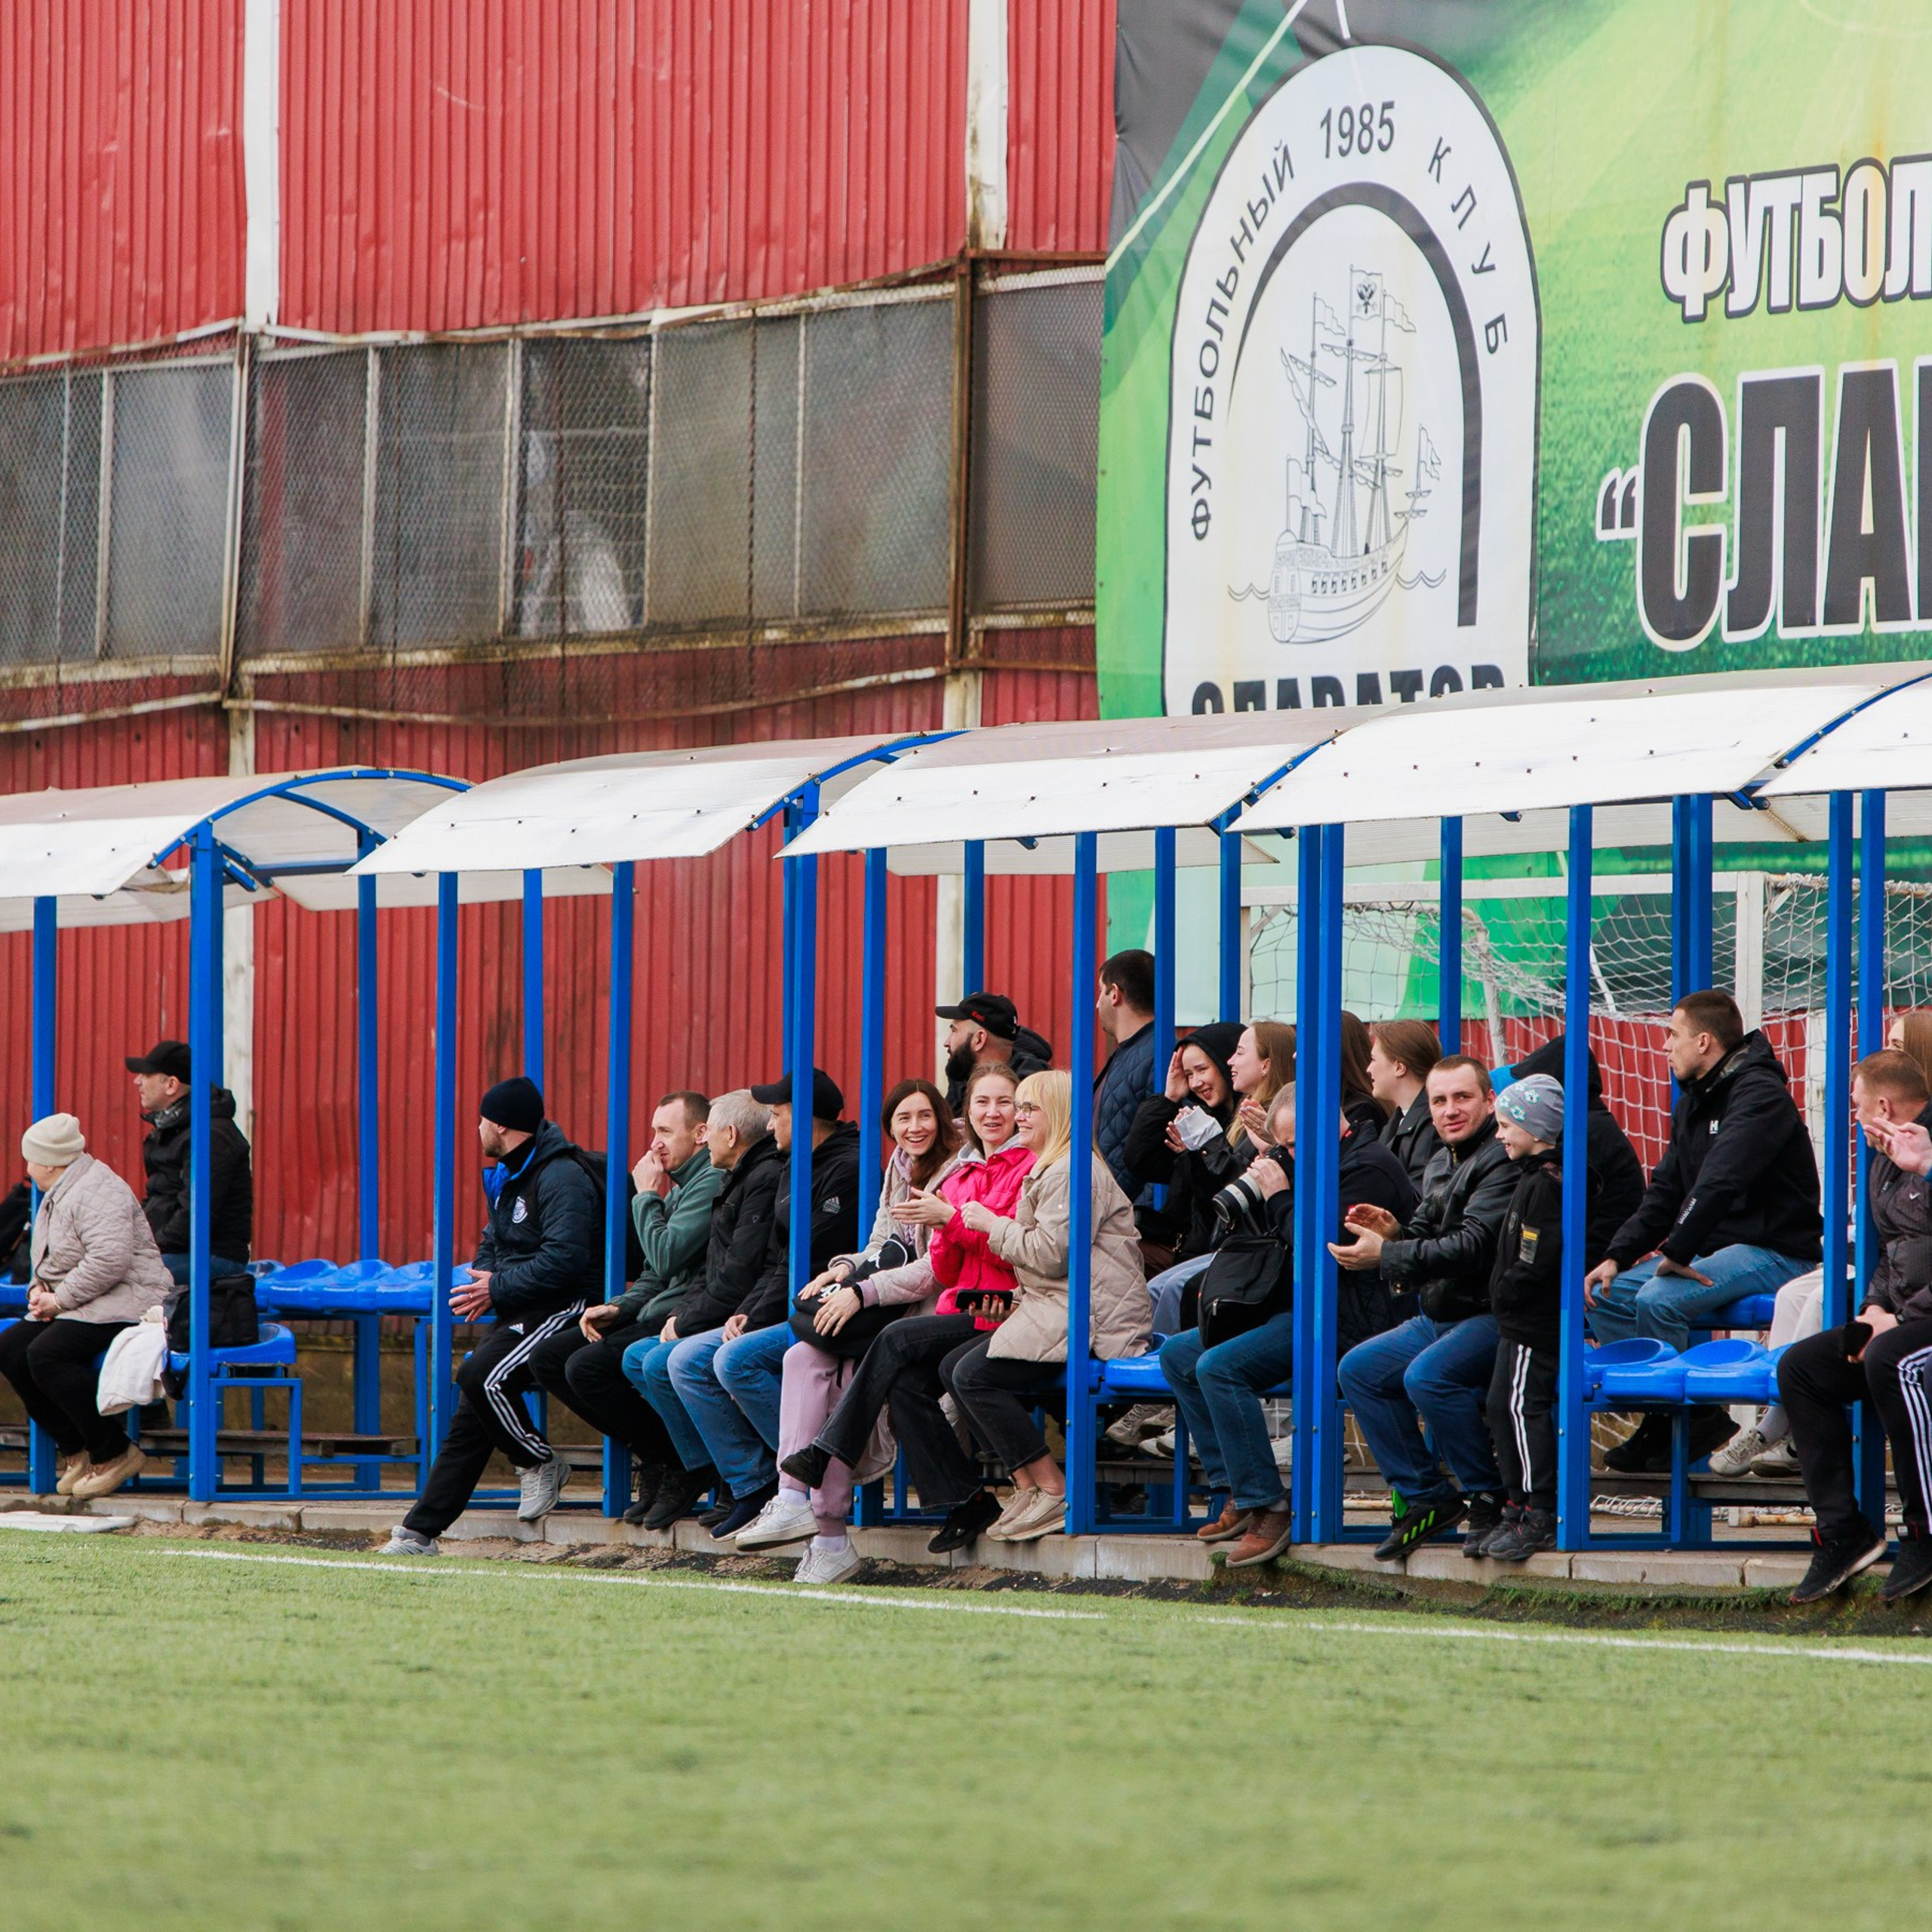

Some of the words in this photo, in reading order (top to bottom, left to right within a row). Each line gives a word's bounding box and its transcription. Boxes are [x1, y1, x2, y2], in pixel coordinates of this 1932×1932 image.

[1319, 100, 1395, 158] 1985
[1191, 139, 1296, 540] ФУТБОЛЬНЫЙ
[1427, 136, 1509, 354] КЛУБ
[1595, 356, 1932, 651] “СЛА
